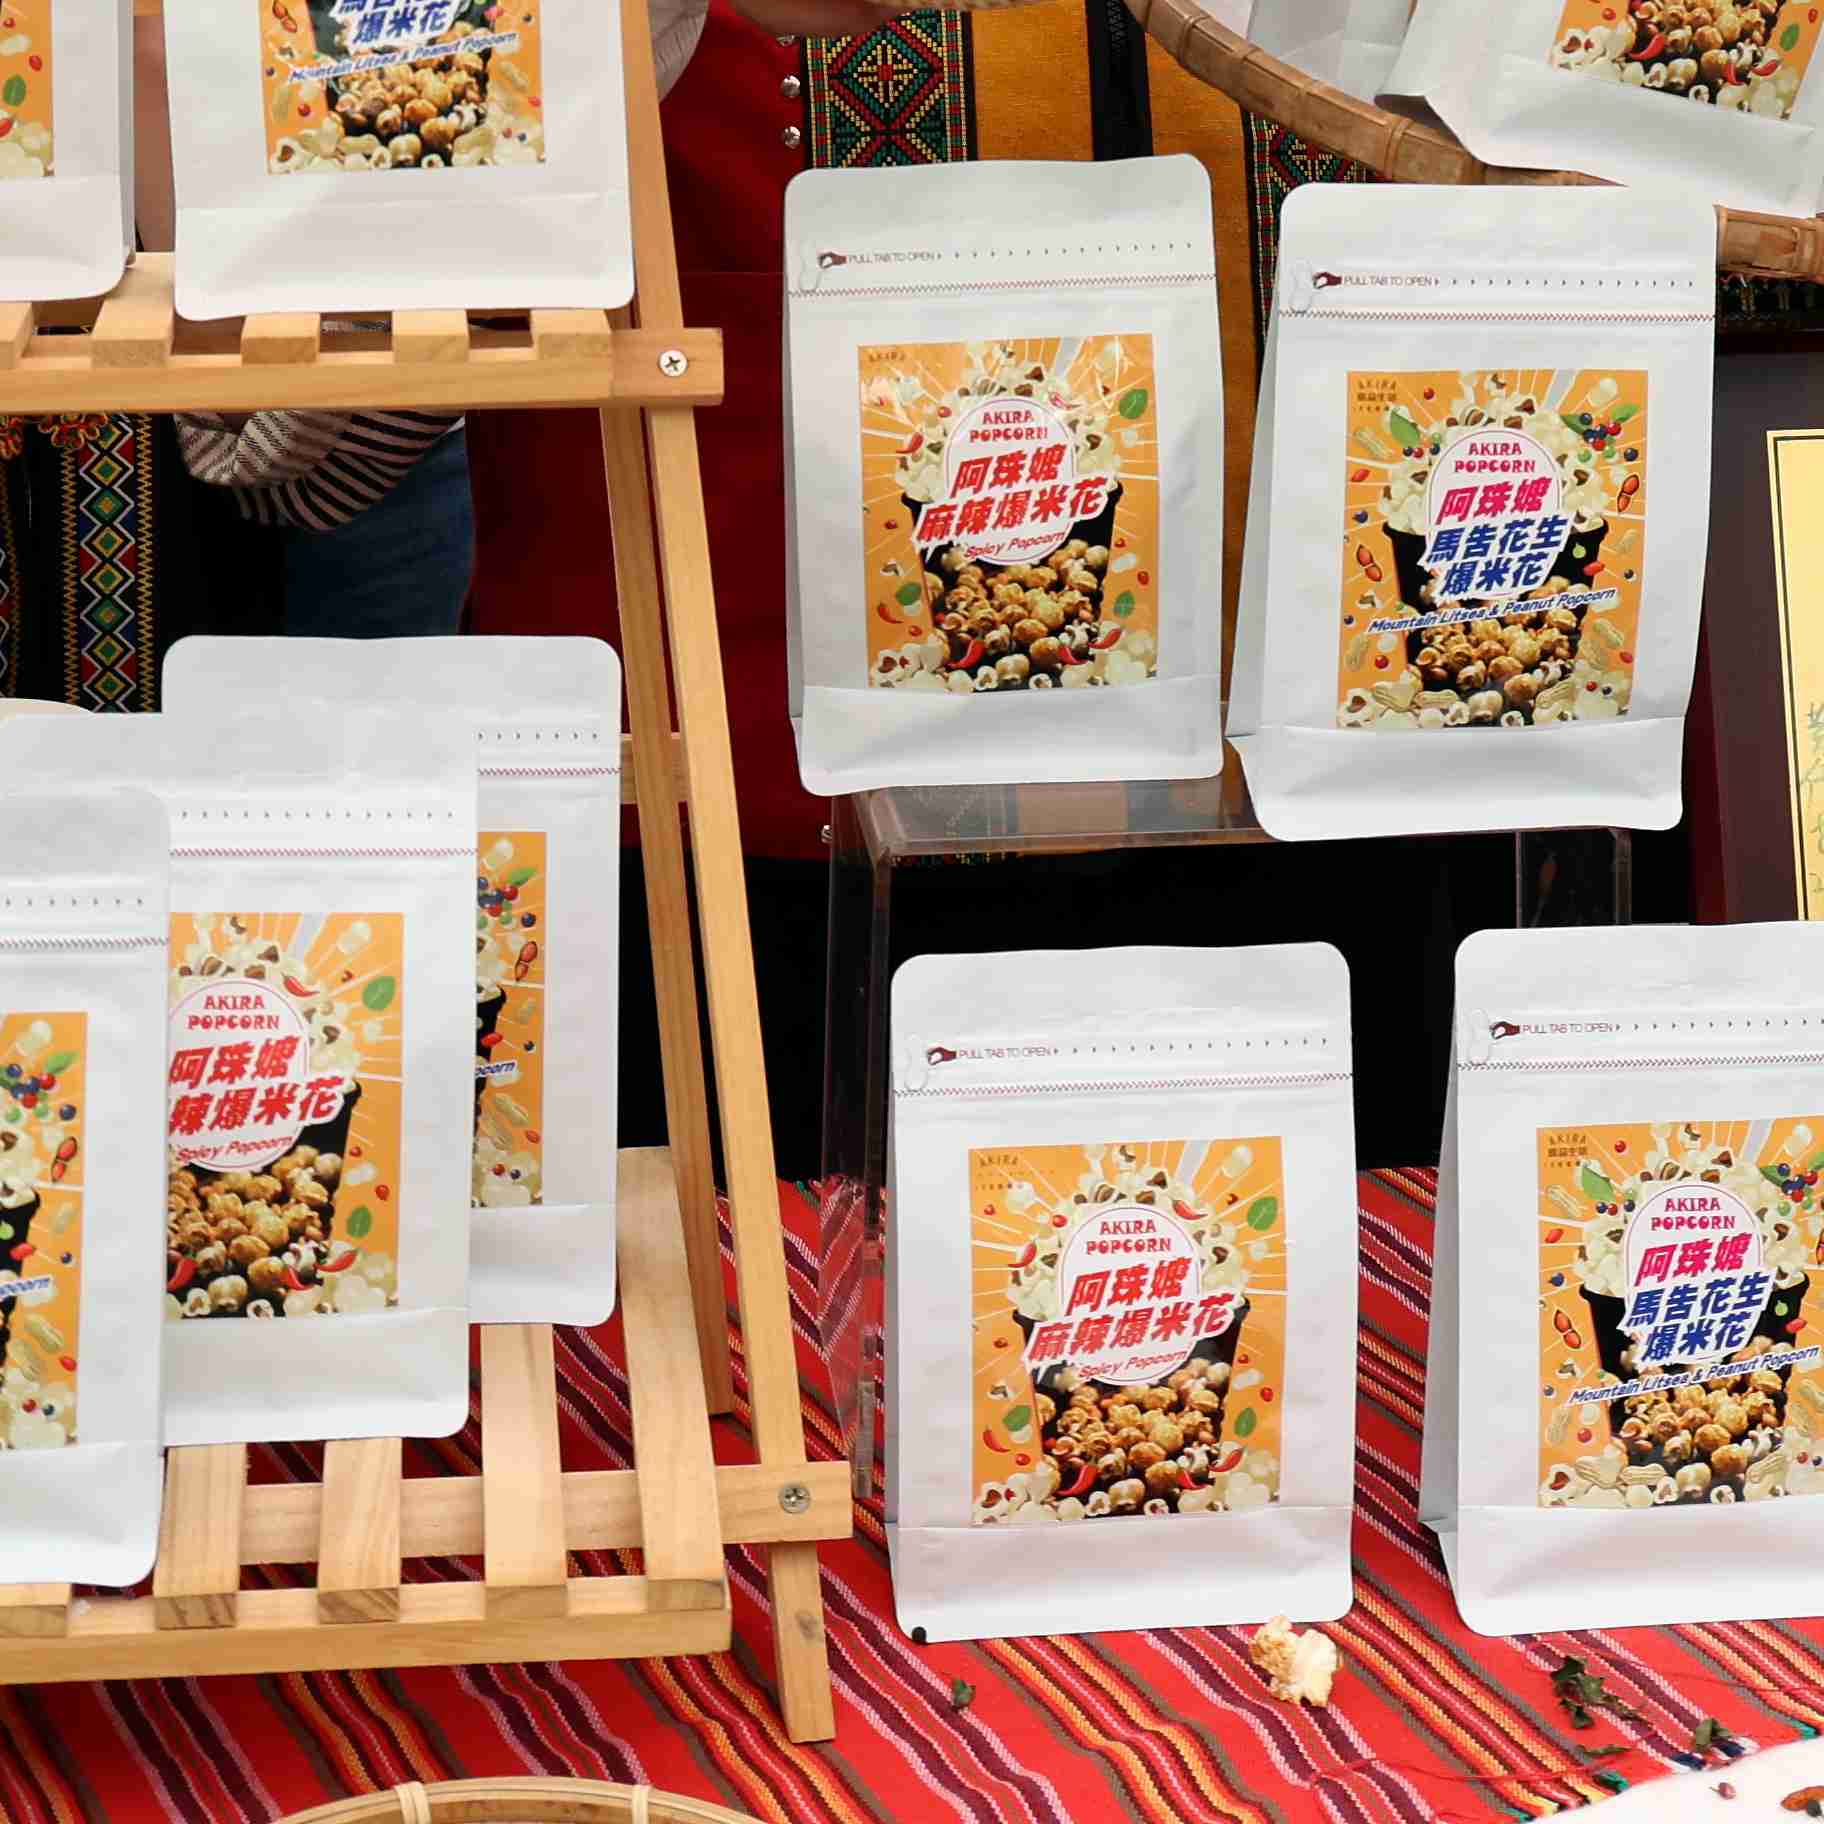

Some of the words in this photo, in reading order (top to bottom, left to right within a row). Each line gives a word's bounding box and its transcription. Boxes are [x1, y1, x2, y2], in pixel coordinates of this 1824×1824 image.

[353, 0, 450, 44] 爆米花
[983, 410, 1033, 424] AKIRA
[969, 427, 1048, 442] POPCORN
[1468, 443, 1522, 456] AKIRA
[1455, 460, 1535, 473] POPCORN
[917, 476, 1107, 541] 麻辣爆米花
[964, 543, 1003, 558] Spicy
[1008, 532, 1066, 551] Popcorn
[1427, 515, 1569, 564] 馬告花生
[1439, 552, 1549, 596] 爆米花
[1368, 615, 1437, 633] Mountain
[1440, 606, 1486, 625] Litsea
[1490, 606, 1499, 616] &
[1503, 596, 1554, 615] Peanut
[1556, 588, 1616, 607] Popcorn
[204, 996, 264, 1009] AKIRA
[188, 1015, 279, 1030] POPCORN
[1664, 1198, 1720, 1213] AKIRA
[1099, 1219, 1156, 1235] AKIRA
[1651, 1216, 1735, 1231] POPCORN
[1086, 1238, 1171, 1255] POPCORN
[1635, 1232, 1753, 1287] 阿珠嬤
[1627, 1272, 1770, 1328] 馬告花生
[1028, 1293, 1235, 1361] 麻辣爆米花
[1641, 1312, 1752, 1362] 爆米花
[1078, 1361, 1122, 1379] Spicy
[1127, 1349, 1187, 1368] Popcorn
[1569, 1382, 1639, 1404] Mountain
[1641, 1375, 1689, 1393] Litsea
[1692, 1371, 1703, 1384] &
[1707, 1358, 1759, 1380] Peanut
[1762, 1347, 1819, 1370] Popcorn
